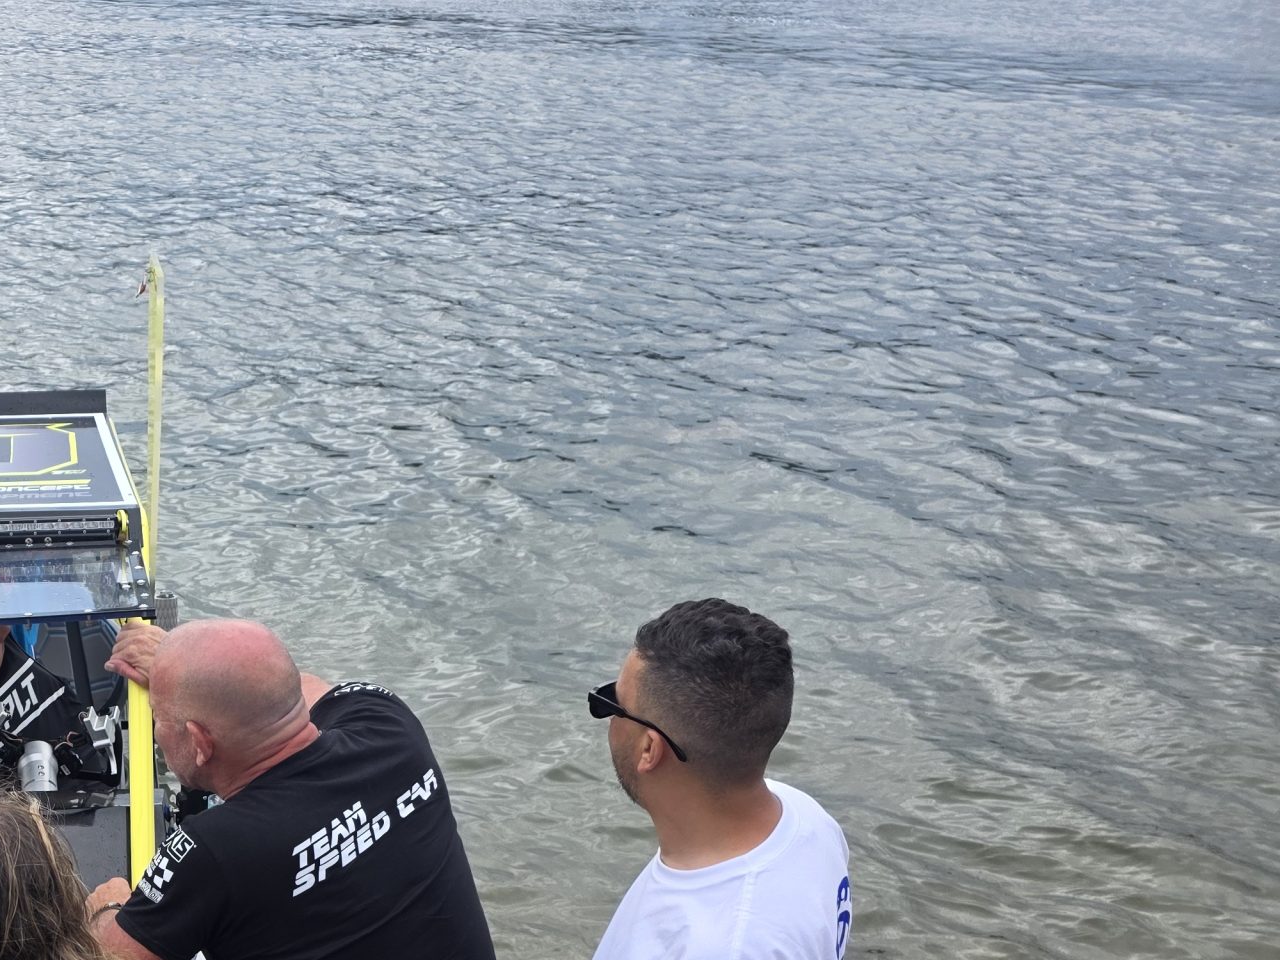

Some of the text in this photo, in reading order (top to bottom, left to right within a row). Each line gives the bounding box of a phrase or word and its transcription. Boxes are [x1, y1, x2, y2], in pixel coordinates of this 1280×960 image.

[292, 801, 367, 869] TEAM
[293, 768, 438, 897] SPEED CAR
